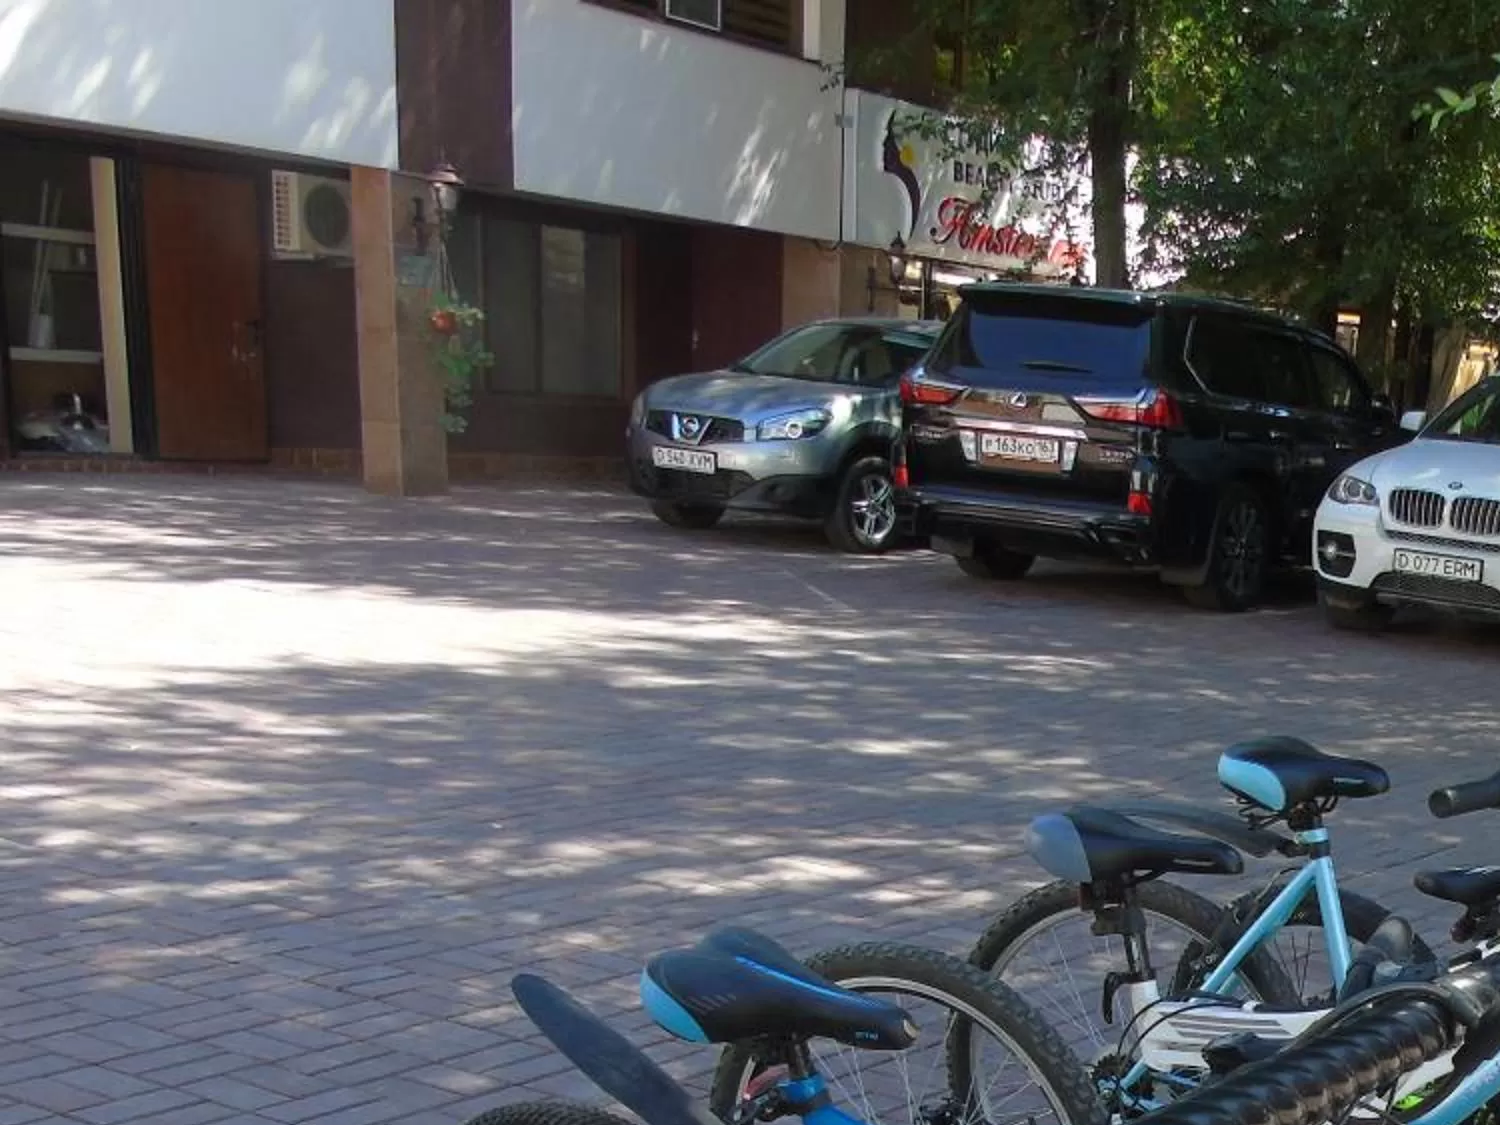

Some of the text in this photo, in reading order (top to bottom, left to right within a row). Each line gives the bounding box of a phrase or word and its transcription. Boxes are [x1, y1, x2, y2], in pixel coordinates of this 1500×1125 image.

[1398, 553, 1476, 577] D 077 ERM
